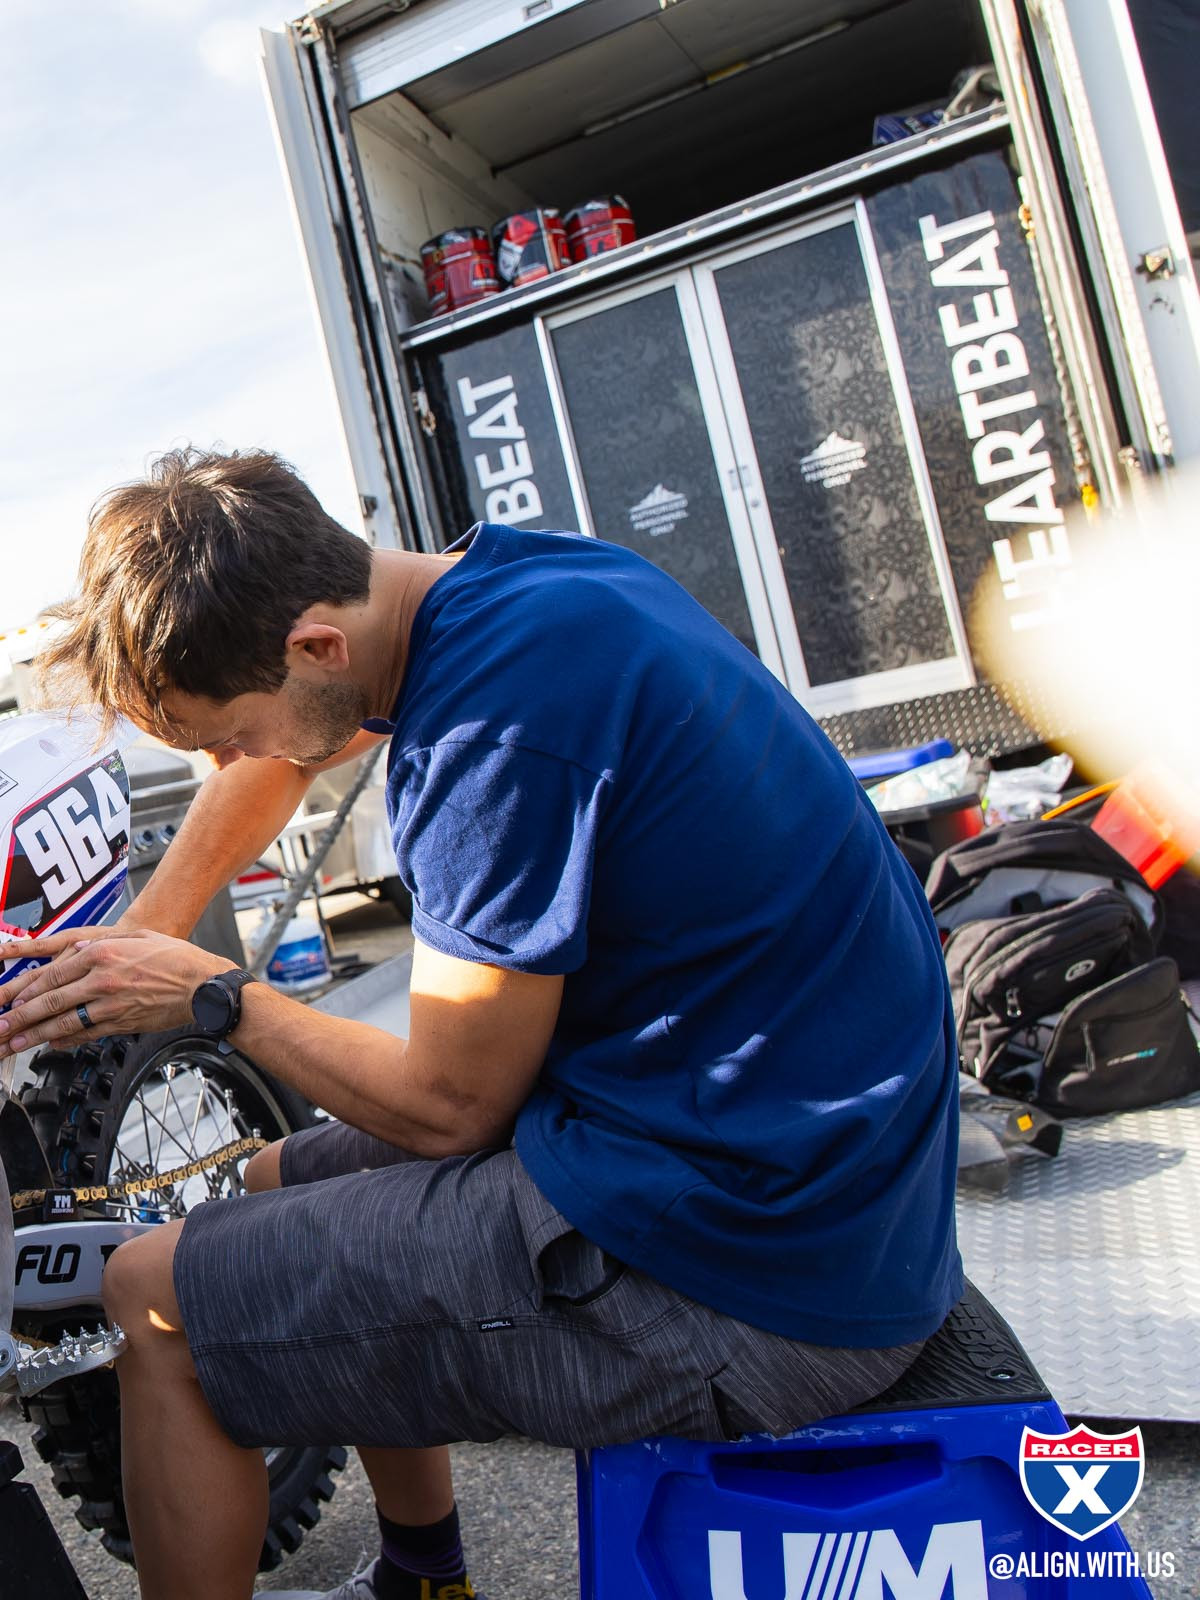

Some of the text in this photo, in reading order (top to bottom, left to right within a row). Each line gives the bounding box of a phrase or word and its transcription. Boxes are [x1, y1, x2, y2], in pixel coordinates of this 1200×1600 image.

[457, 375, 544, 525] BEAT
[15, 766, 131, 911] 964
[54, 1194, 71, 1208] TM
[14, 1243, 82, 1286] FLO
